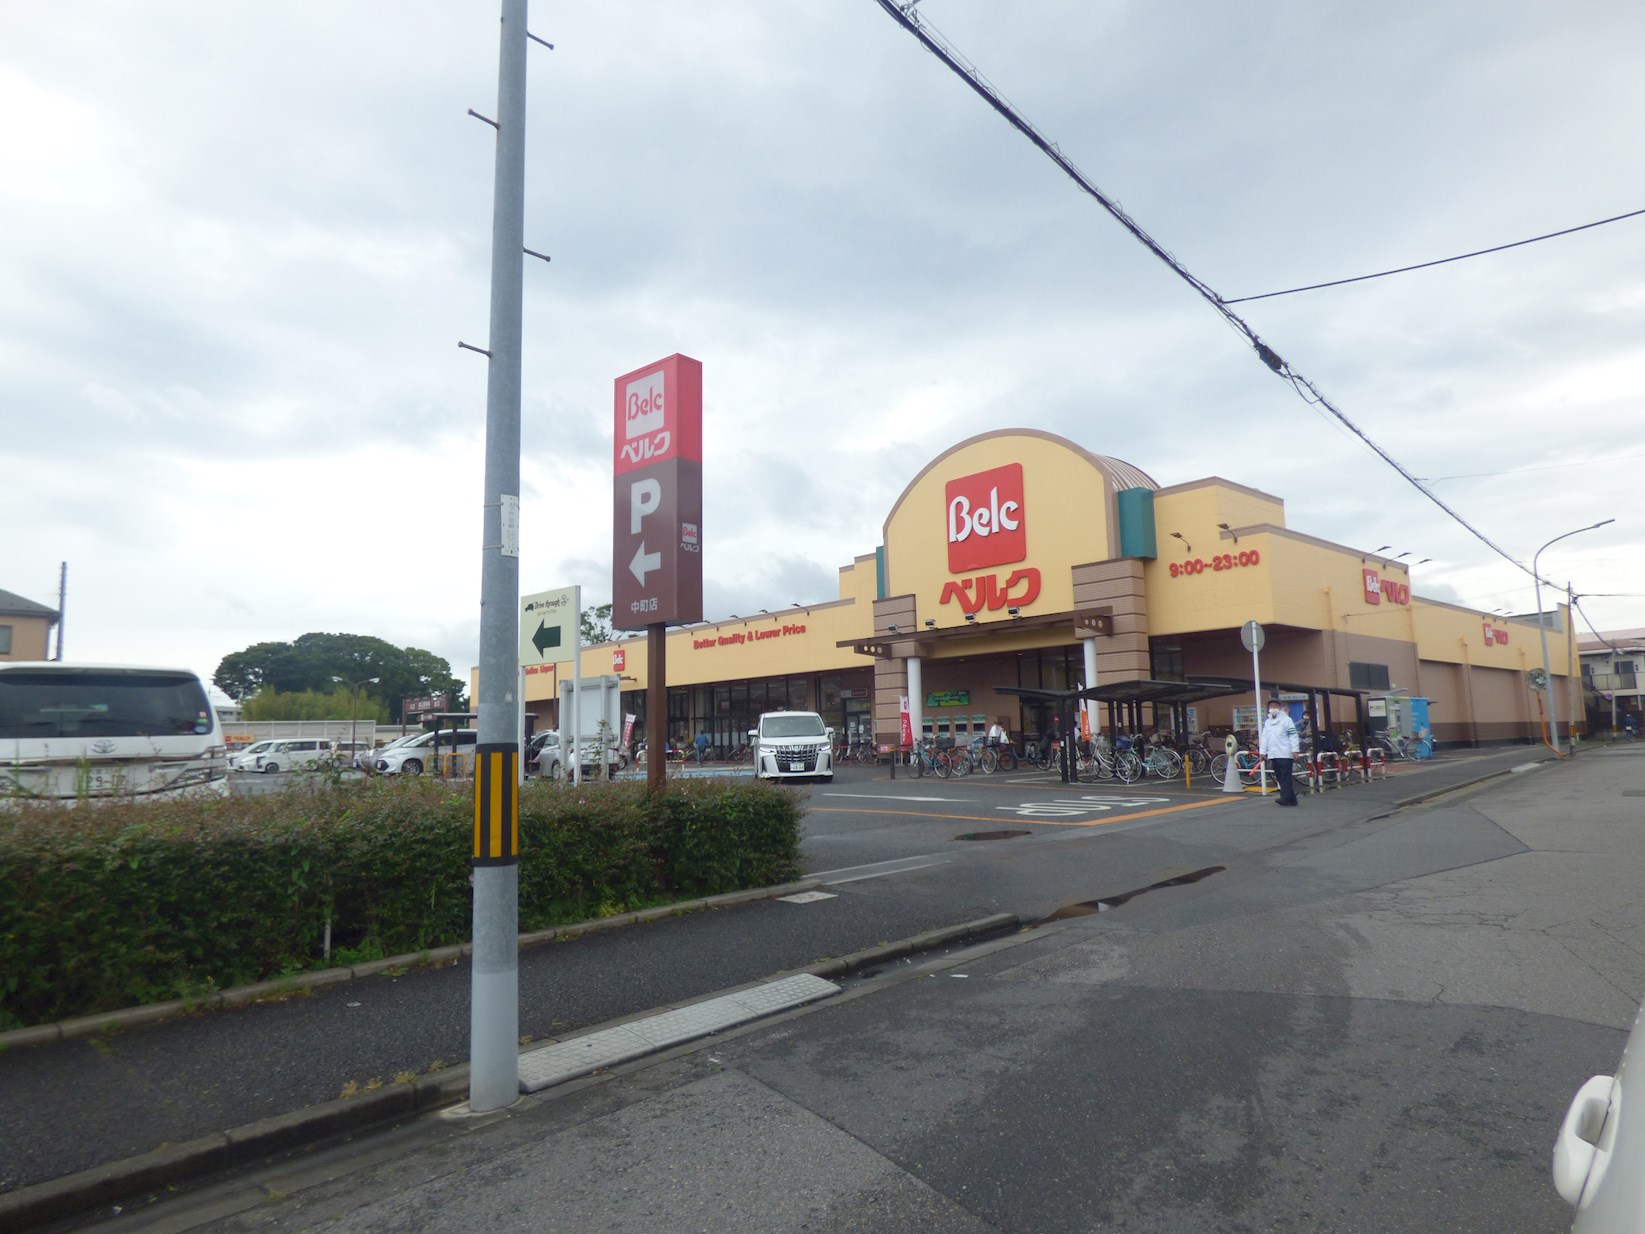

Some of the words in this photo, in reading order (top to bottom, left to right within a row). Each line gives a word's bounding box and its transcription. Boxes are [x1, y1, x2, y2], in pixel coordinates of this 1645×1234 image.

[627, 385, 663, 421] Belc
[620, 430, 671, 464] ベルク
[631, 478, 661, 535] P
[949, 486, 1020, 543] Belc
[631, 597, 658, 614] 中町店
[939, 567, 1042, 615] ベルク
[693, 638, 717, 650] Better
[718, 633, 746, 645] Quality
[747, 631, 753, 641] &
[755, 629, 781, 640] Lower
[782, 624, 806, 636] Price
